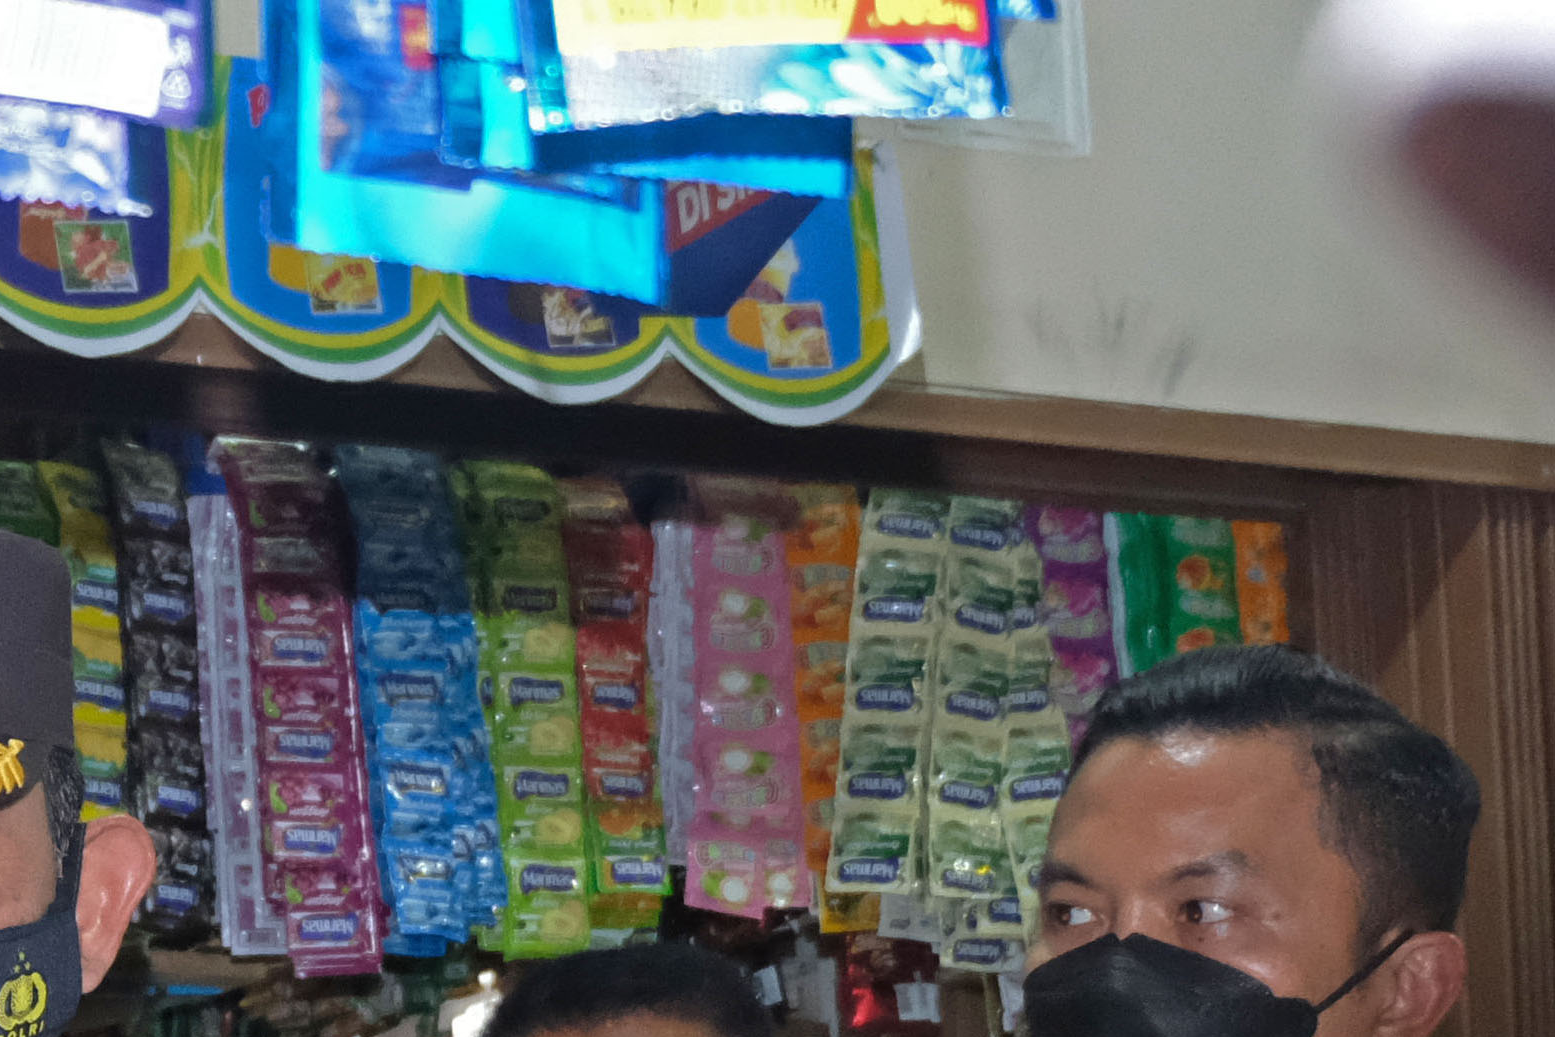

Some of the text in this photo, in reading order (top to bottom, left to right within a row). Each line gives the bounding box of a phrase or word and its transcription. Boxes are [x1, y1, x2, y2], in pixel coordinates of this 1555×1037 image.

[513, 686, 561, 701] Marimas
[851, 777, 904, 795] Marimas
[286, 829, 337, 848] Marimas
[843, 862, 895, 880] Marimas
[303, 918, 355, 937] Marimas
